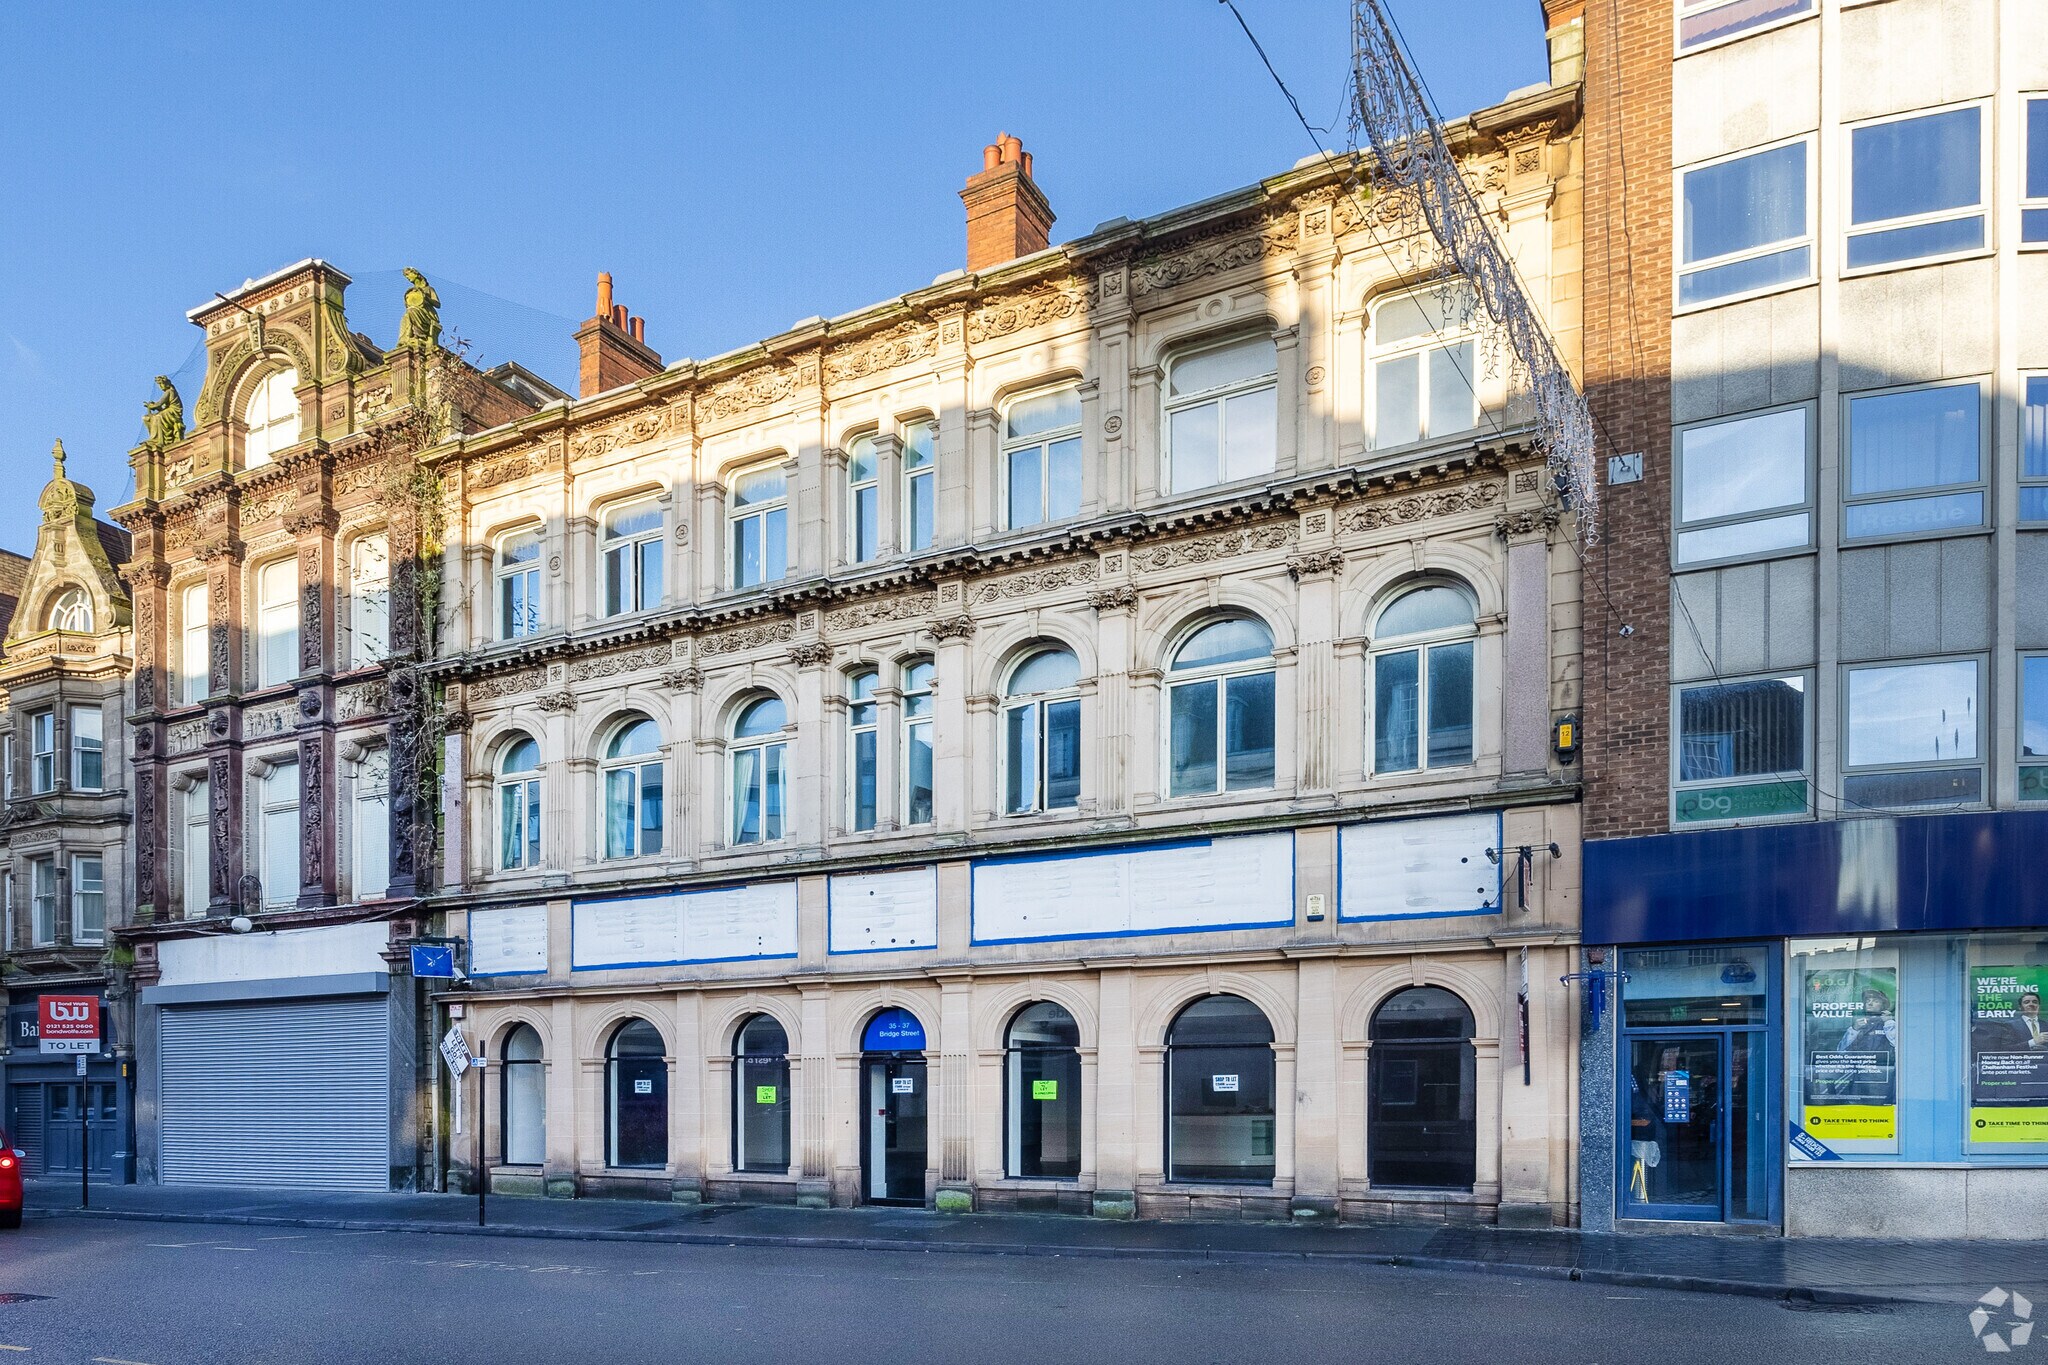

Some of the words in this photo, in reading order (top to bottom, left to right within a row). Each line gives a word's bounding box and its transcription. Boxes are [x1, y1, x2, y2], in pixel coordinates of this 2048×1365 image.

[1977, 985, 2039, 993] STARTING
[1812, 1002, 1864, 1010] PROPER
[1812, 1010, 1853, 1018] VALUE
[1977, 1010, 2016, 1018] EARLY
[48, 1042, 66, 1050] TO
[70, 1042, 92, 1050] LET
